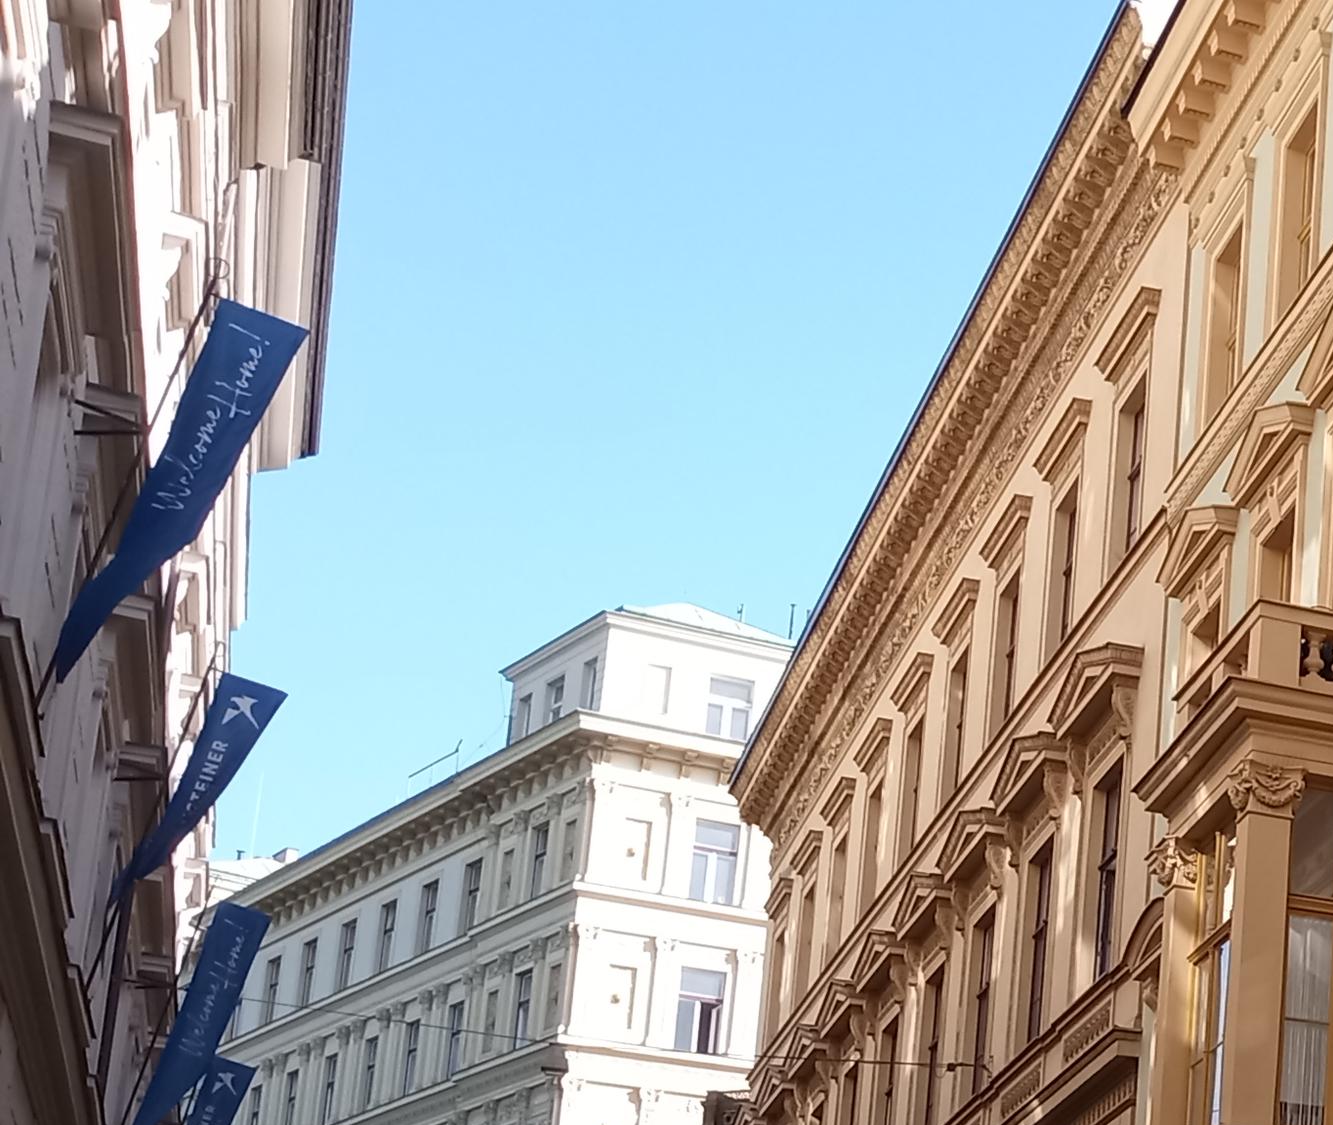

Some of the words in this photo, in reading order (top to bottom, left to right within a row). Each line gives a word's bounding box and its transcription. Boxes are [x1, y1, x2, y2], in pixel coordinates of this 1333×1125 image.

[151, 405, 223, 511] Welcome
[208, 322, 272, 420] Home!
[178, 981, 220, 1056] Welcome
